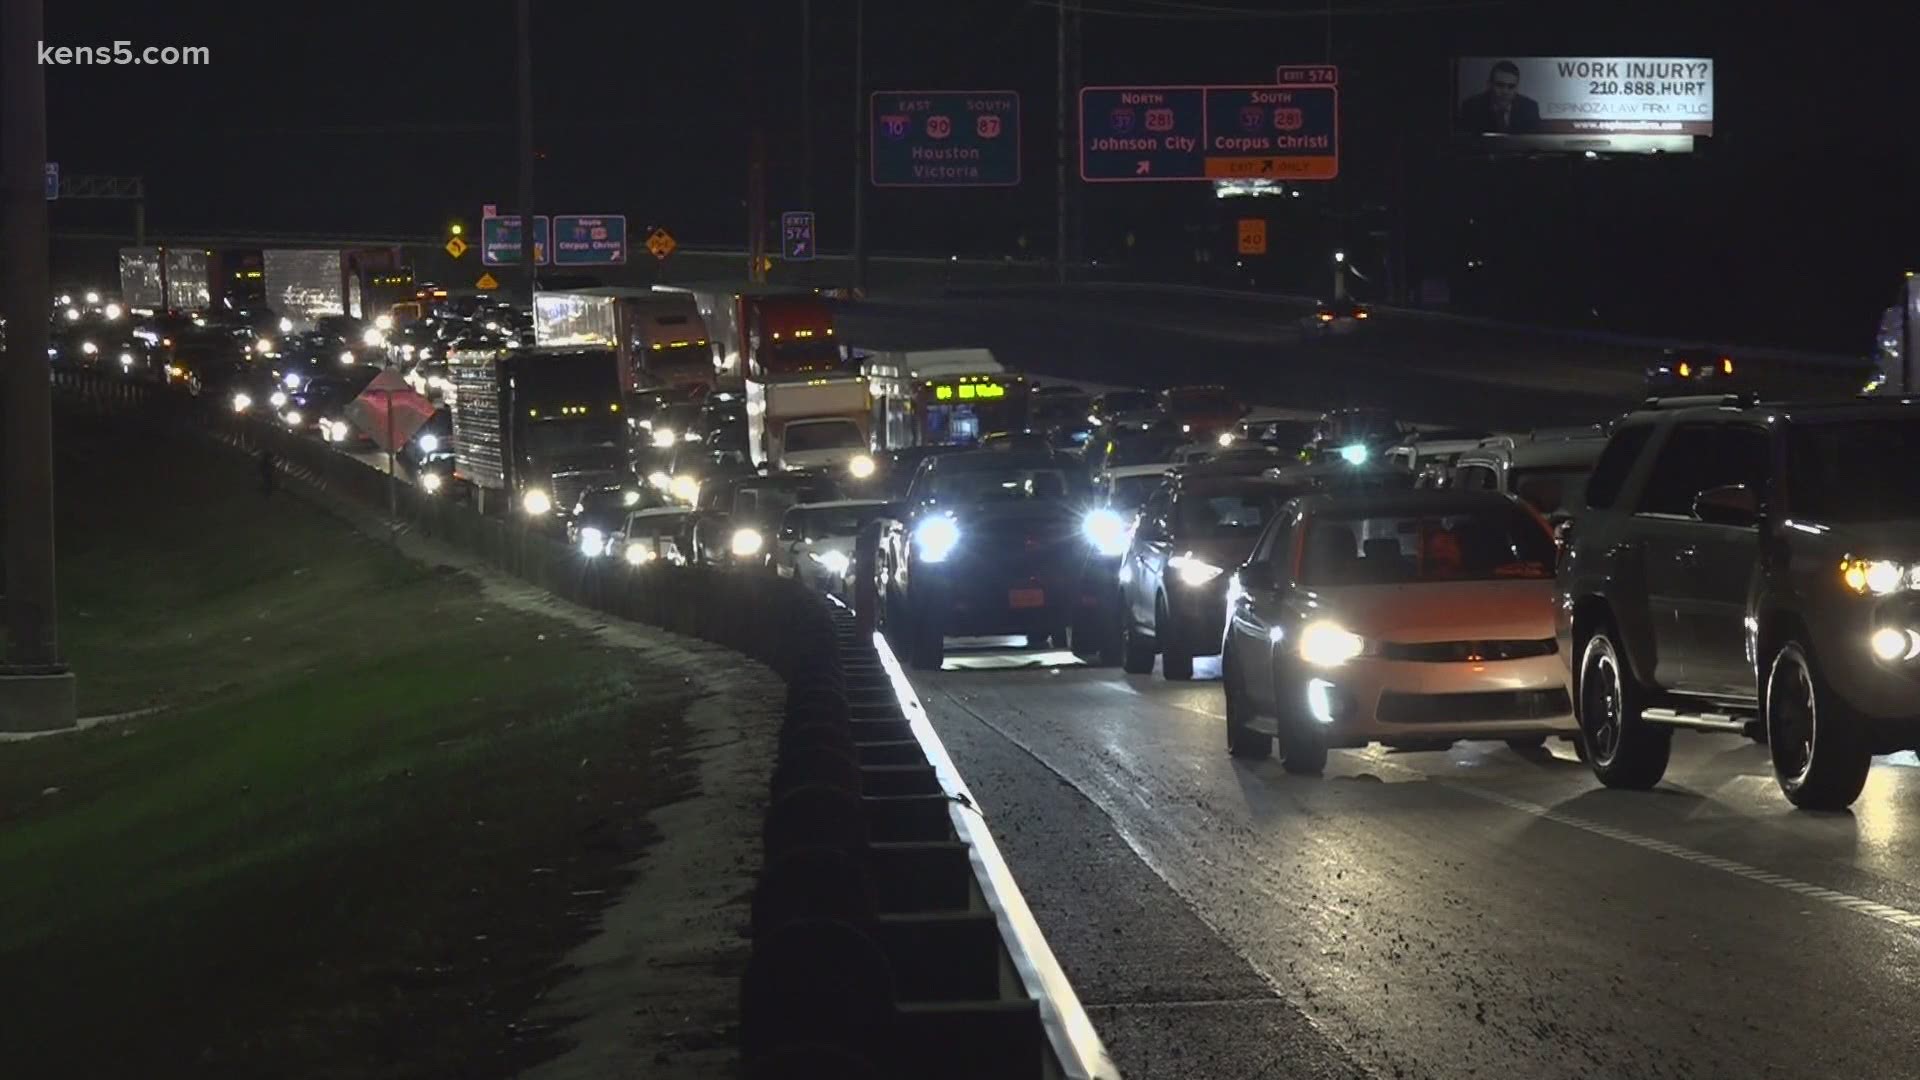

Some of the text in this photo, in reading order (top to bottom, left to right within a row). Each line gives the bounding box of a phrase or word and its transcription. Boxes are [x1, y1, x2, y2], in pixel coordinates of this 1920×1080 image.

[1308, 70, 1333, 82] 574
[1558, 62, 1708, 78] WORK INJURY?
[1589, 81, 1706, 96] 210.888.HURT
[1122, 92, 1164, 104] NORTH
[1251, 91, 1292, 103] SOUTH
[899, 101, 932, 111] EAST
[967, 100, 1011, 111] SOUTH
[1610, 103, 1639, 115] LAW
[929, 119, 949, 133] 90
[979, 119, 998, 133] 87
[1148, 112, 1172, 127] 281
[1276, 112, 1300, 127] 281
[889, 121, 904, 135] 10
[1090, 135, 1196, 152] Johnson City
[1215, 134, 1328, 151] Corpus Christi
[912, 146, 980, 159] Houston
[912, 165, 978, 177] Victoria
[786, 228, 811, 240] 574
[1242, 234, 1262, 245] 40
